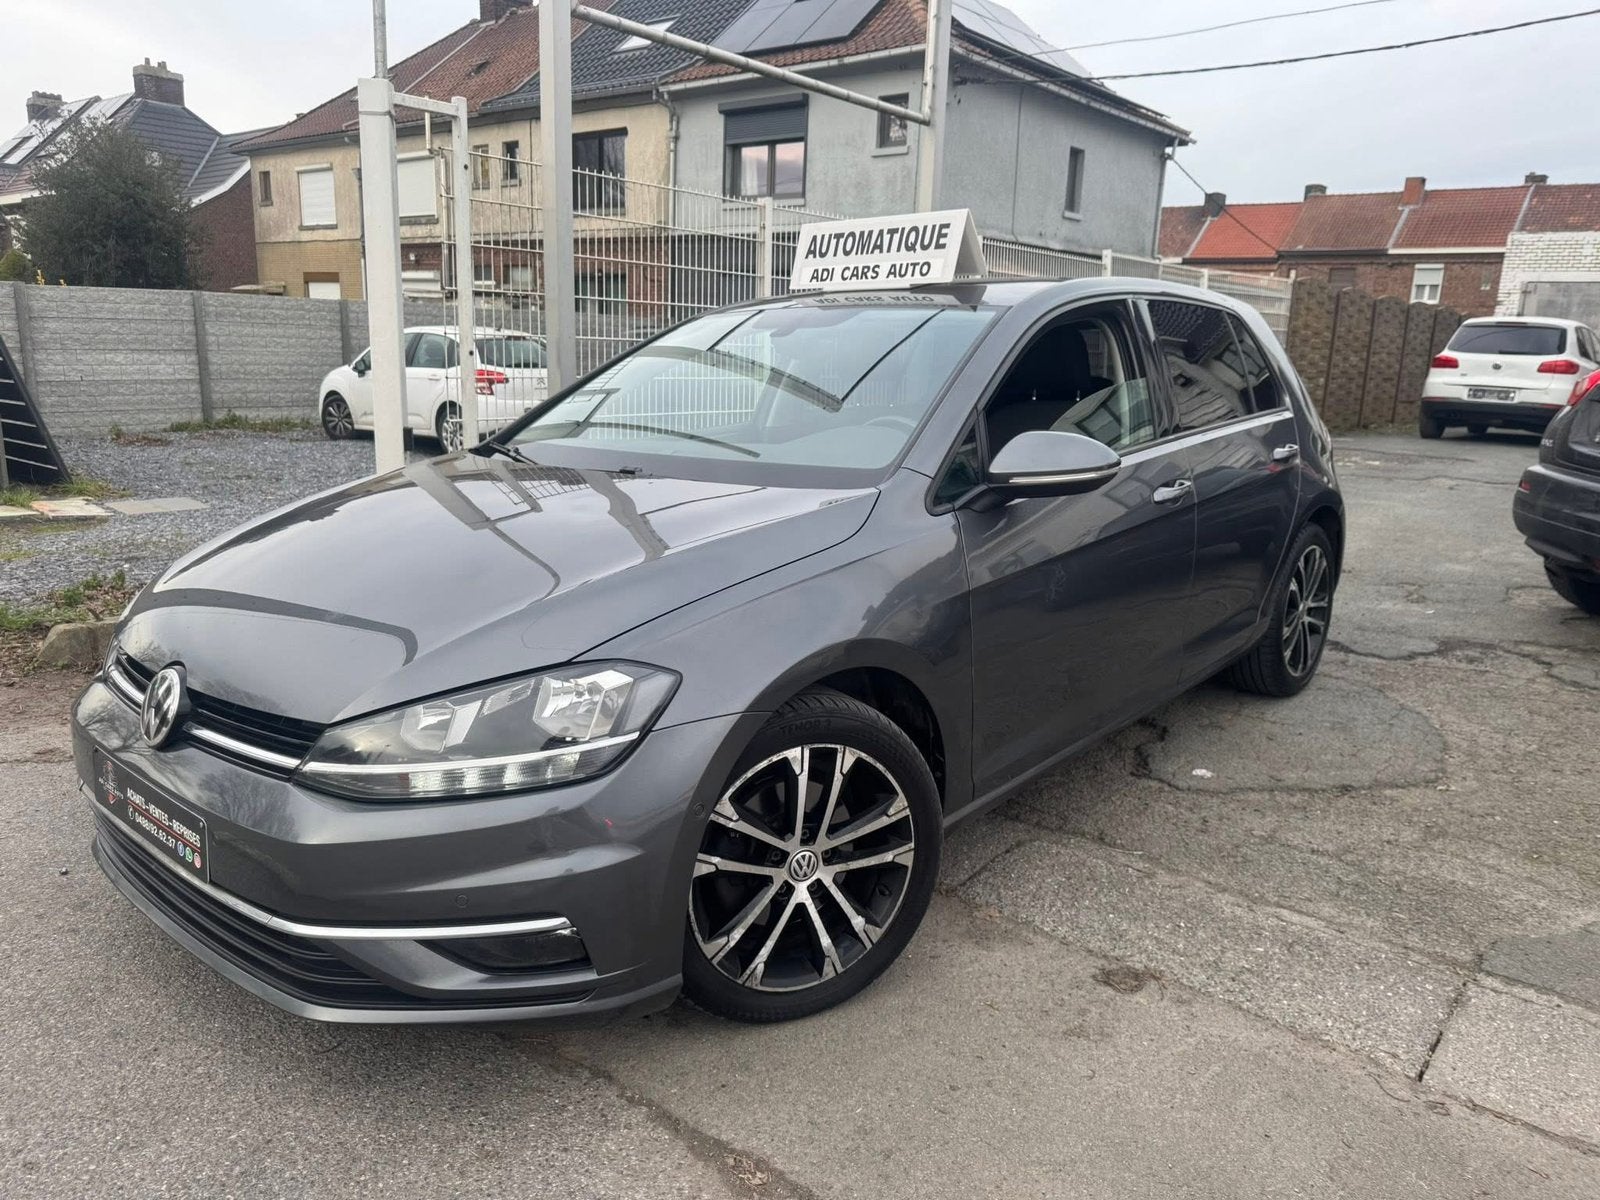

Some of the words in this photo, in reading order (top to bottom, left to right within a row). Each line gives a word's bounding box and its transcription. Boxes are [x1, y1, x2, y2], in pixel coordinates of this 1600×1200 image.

[804, 222, 951, 260] AUTOMATIQUE
[809, 268, 835, 283] ADI
[841, 264, 881, 281] CARS
[886, 261, 932, 279] AUTO
